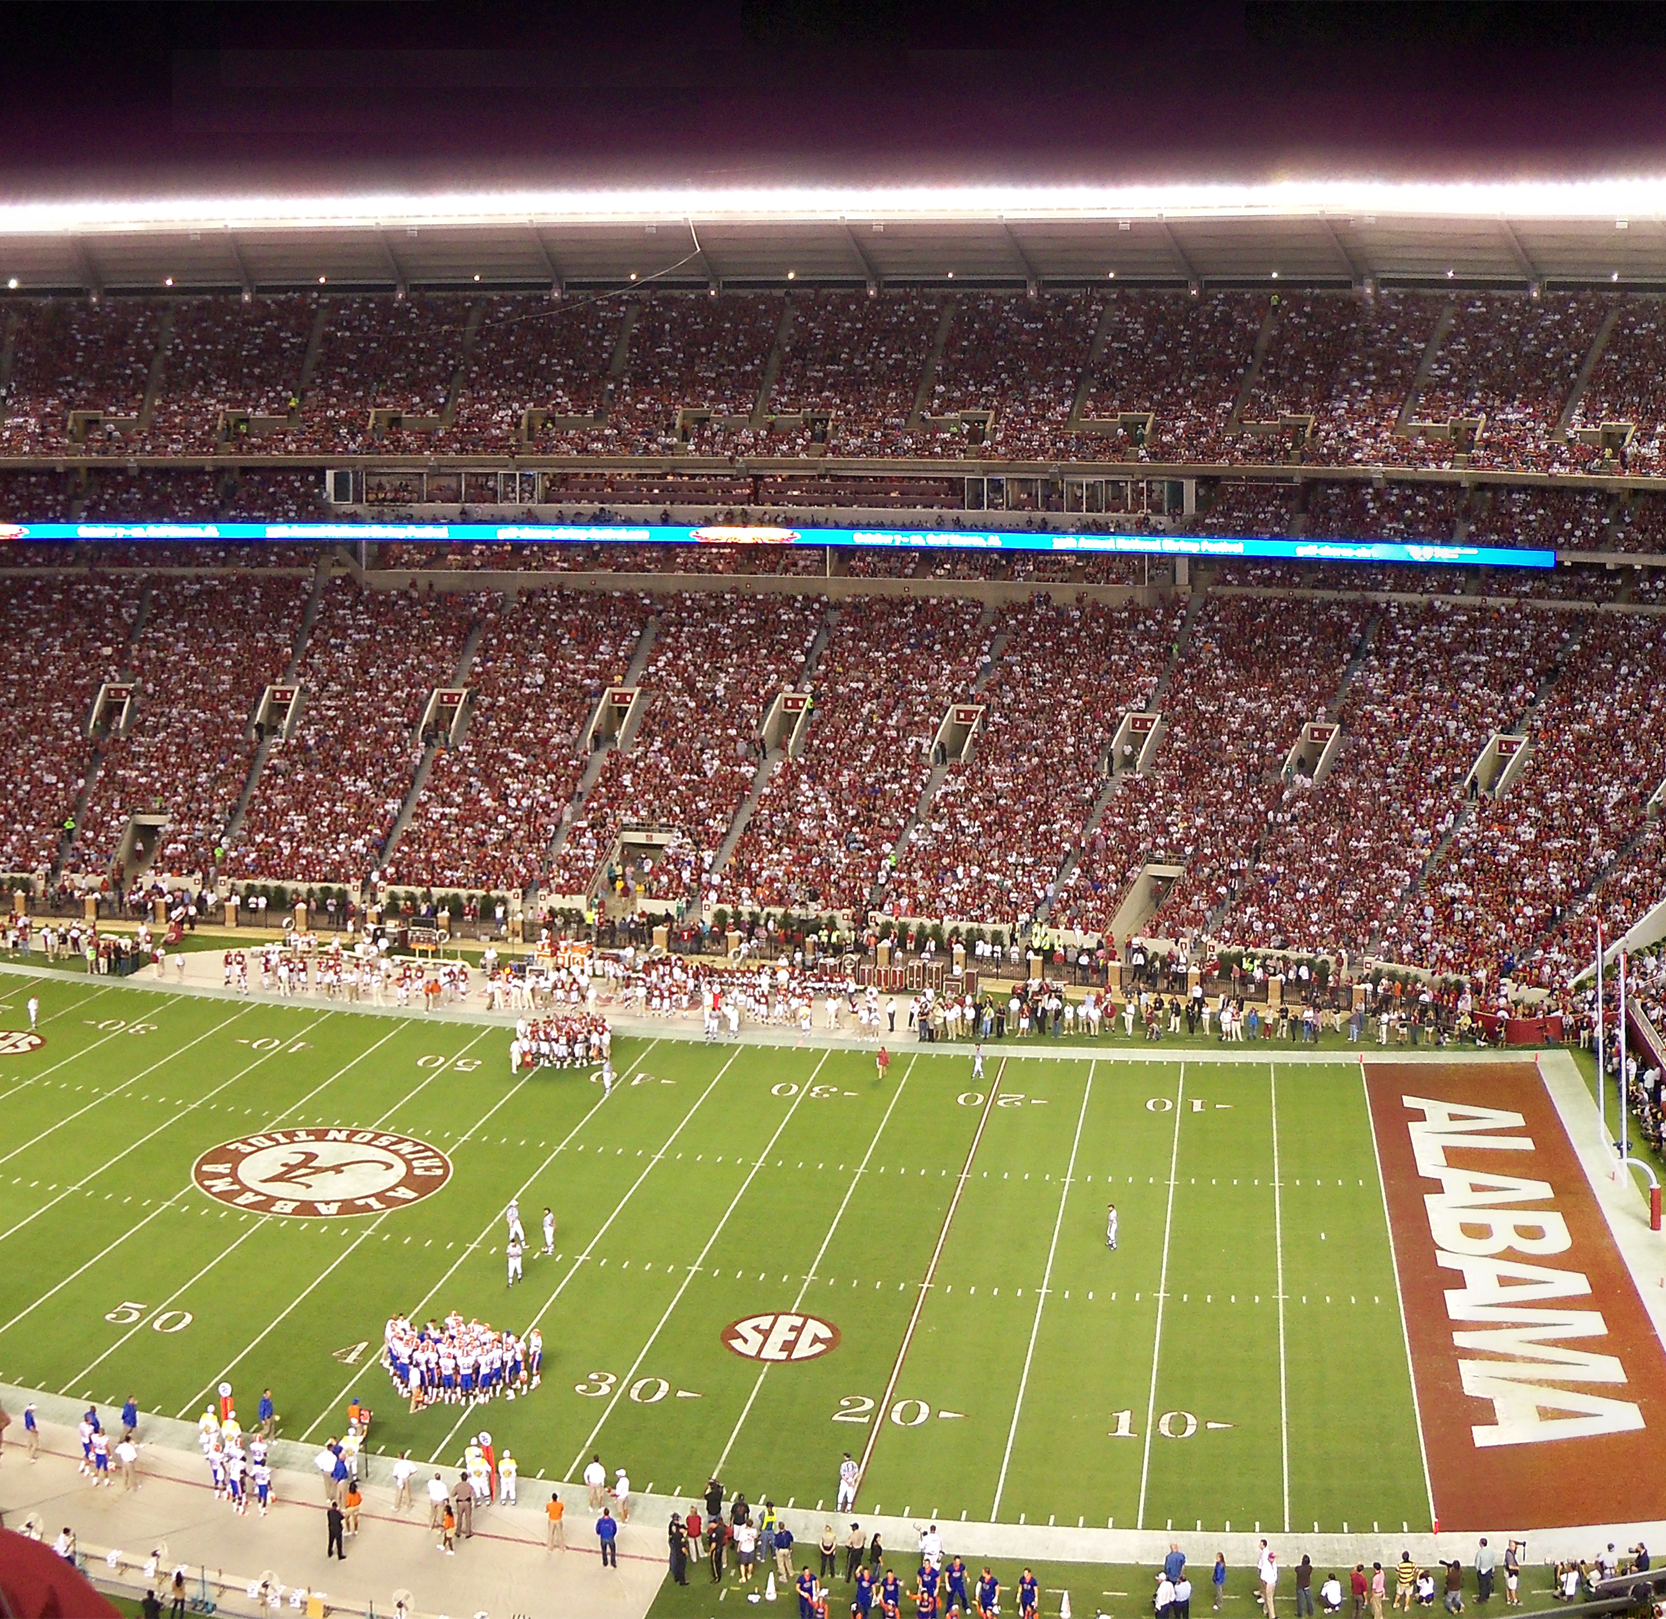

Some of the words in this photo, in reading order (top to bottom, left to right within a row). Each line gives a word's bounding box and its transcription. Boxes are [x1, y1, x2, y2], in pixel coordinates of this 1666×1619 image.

[99, 1019, 159, 1034] 30
[250, 1038, 313, 1053] 40
[416, 1054, 484, 1072] 50
[770, 1082, 840, 1098] 30
[956, 1092, 1028, 1107] 20
[1144, 1097, 1207, 1113] 10
[225, 1129, 318, 1153] TIDE
[327, 1129, 444, 1176] CRIMSON
[201, 1162, 419, 1215] ALABAMA
[1401, 1094, 1647, 1448] ALABAMA
[104, 1301, 194, 1333] 50
[728, 1315, 835, 1361] SEC
[333, 1341, 369, 1364] 4
[574, 1372, 672, 1402] 30
[832, 1396, 930, 1426] 20
[1108, 1409, 1198, 1438] 10
